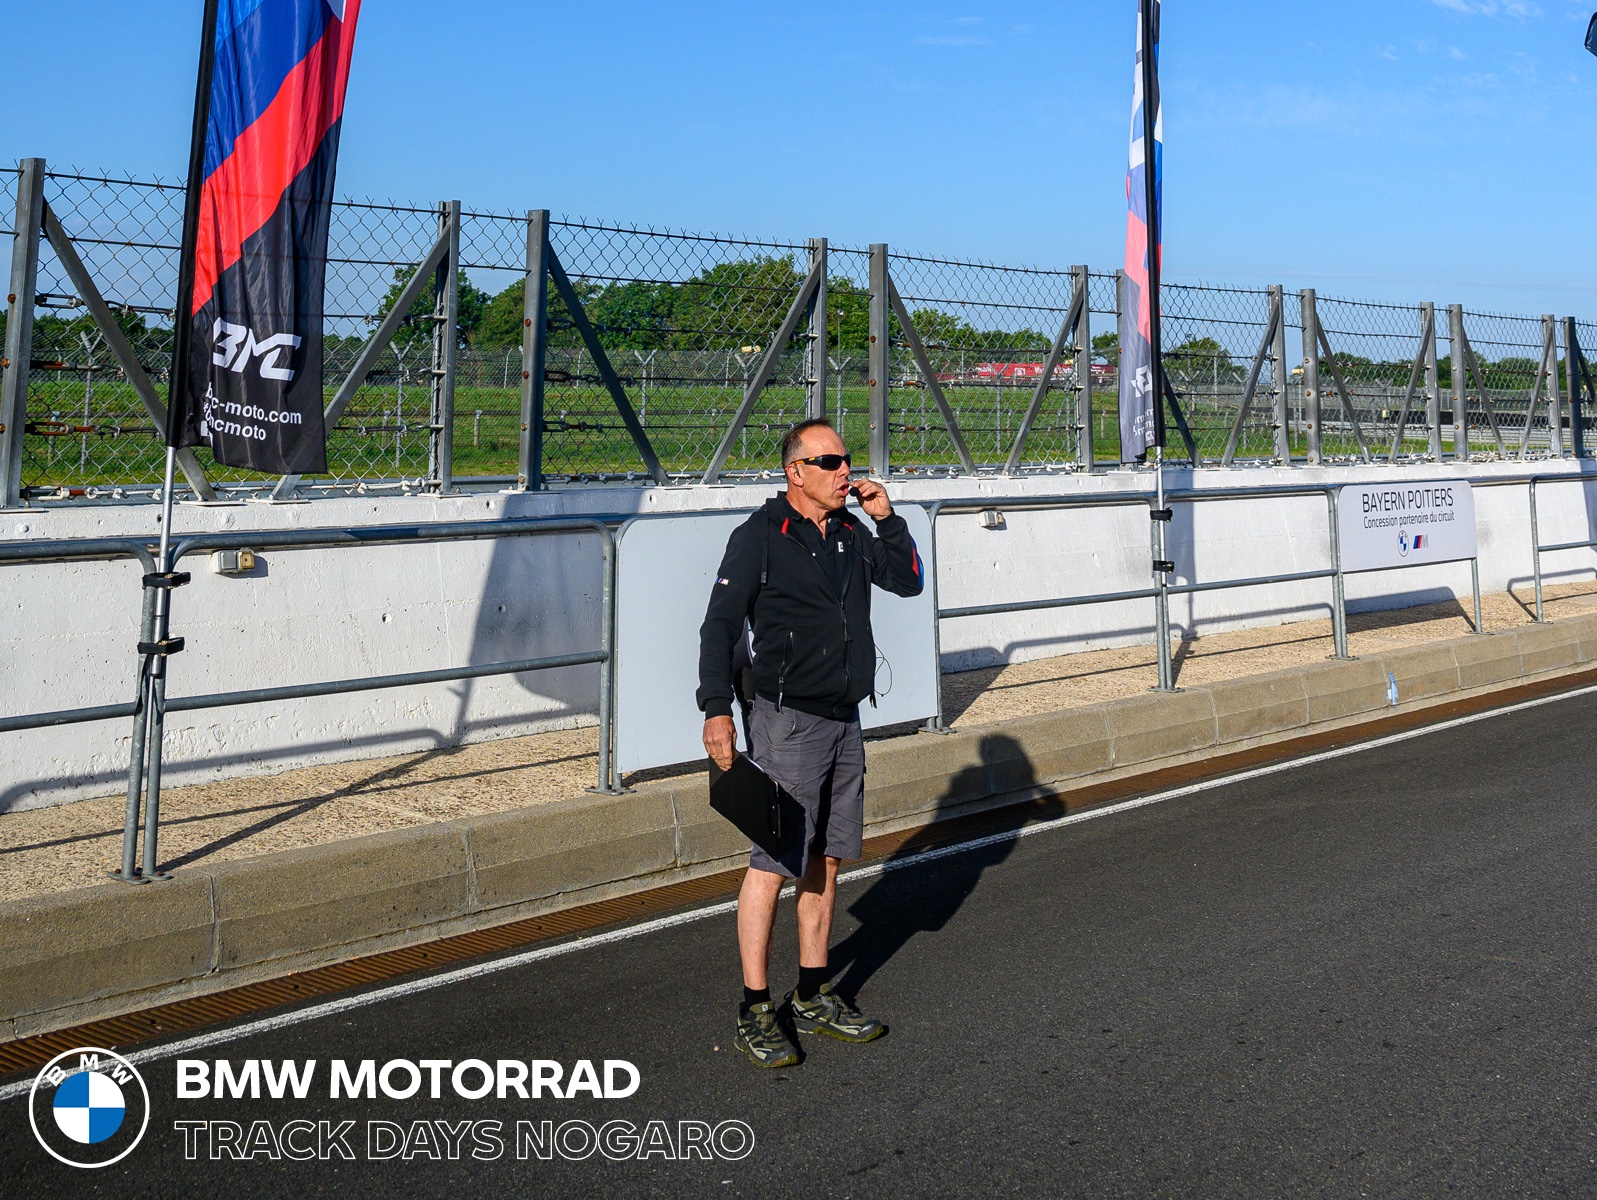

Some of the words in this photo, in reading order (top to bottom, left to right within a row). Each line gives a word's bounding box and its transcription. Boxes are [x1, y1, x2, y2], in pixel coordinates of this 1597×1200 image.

[205, 381, 302, 425] bc-moto.com
[1362, 491, 1406, 513] BAYERN
[1408, 487, 1454, 509] POITIERS
[1363, 514, 1398, 529] Concession
[1399, 511, 1429, 528] partenaire
[1429, 511, 1438, 523] du
[1438, 509, 1455, 522] circuit
